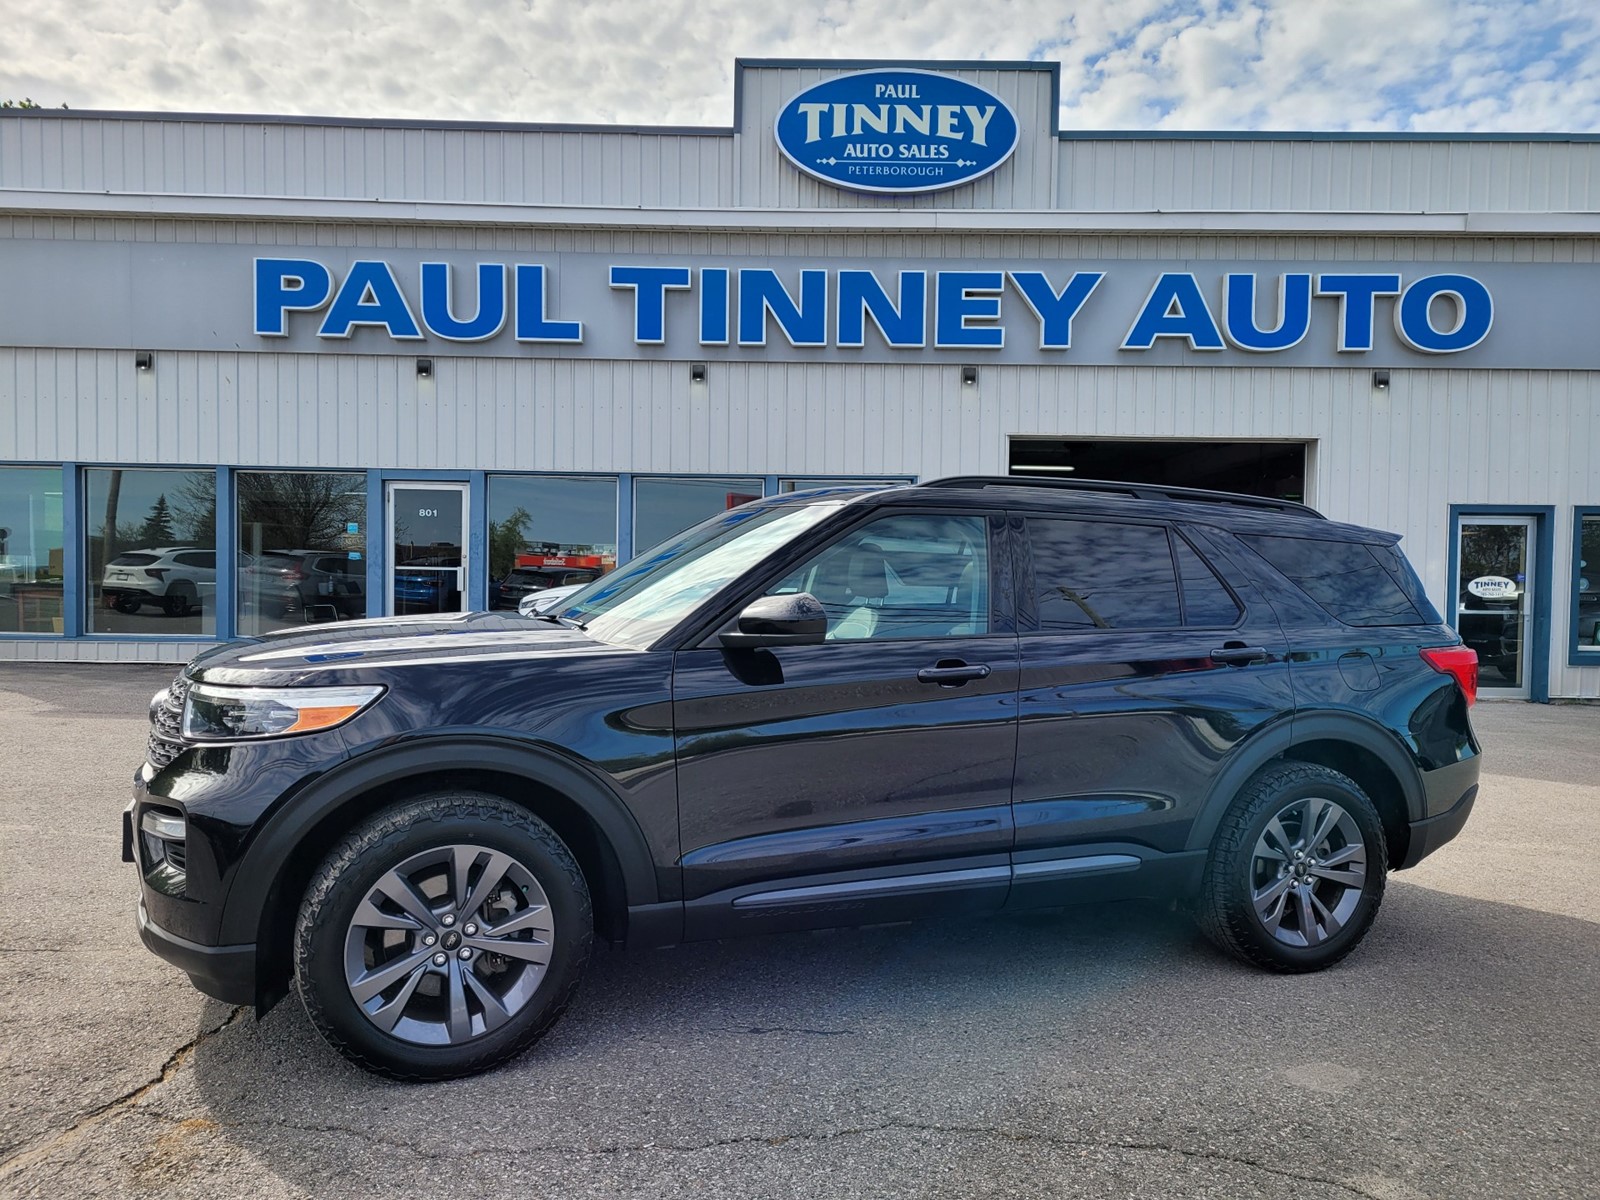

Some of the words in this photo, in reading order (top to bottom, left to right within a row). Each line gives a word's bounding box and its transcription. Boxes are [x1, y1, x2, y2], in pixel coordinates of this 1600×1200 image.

[875, 84, 921, 99] PAUL
[797, 102, 997, 147] TINNEY
[843, 143, 894, 159] AUTO
[899, 144, 949, 159] SALES
[848, 165, 944, 176] PETERBOROUGH
[253, 257, 584, 343] PAUL
[609, 265, 1107, 351] TINNEY
[1118, 272, 1495, 355] AUTO
[418, 508, 438, 517] 801
[1474, 581, 1509, 589] TINNEY
